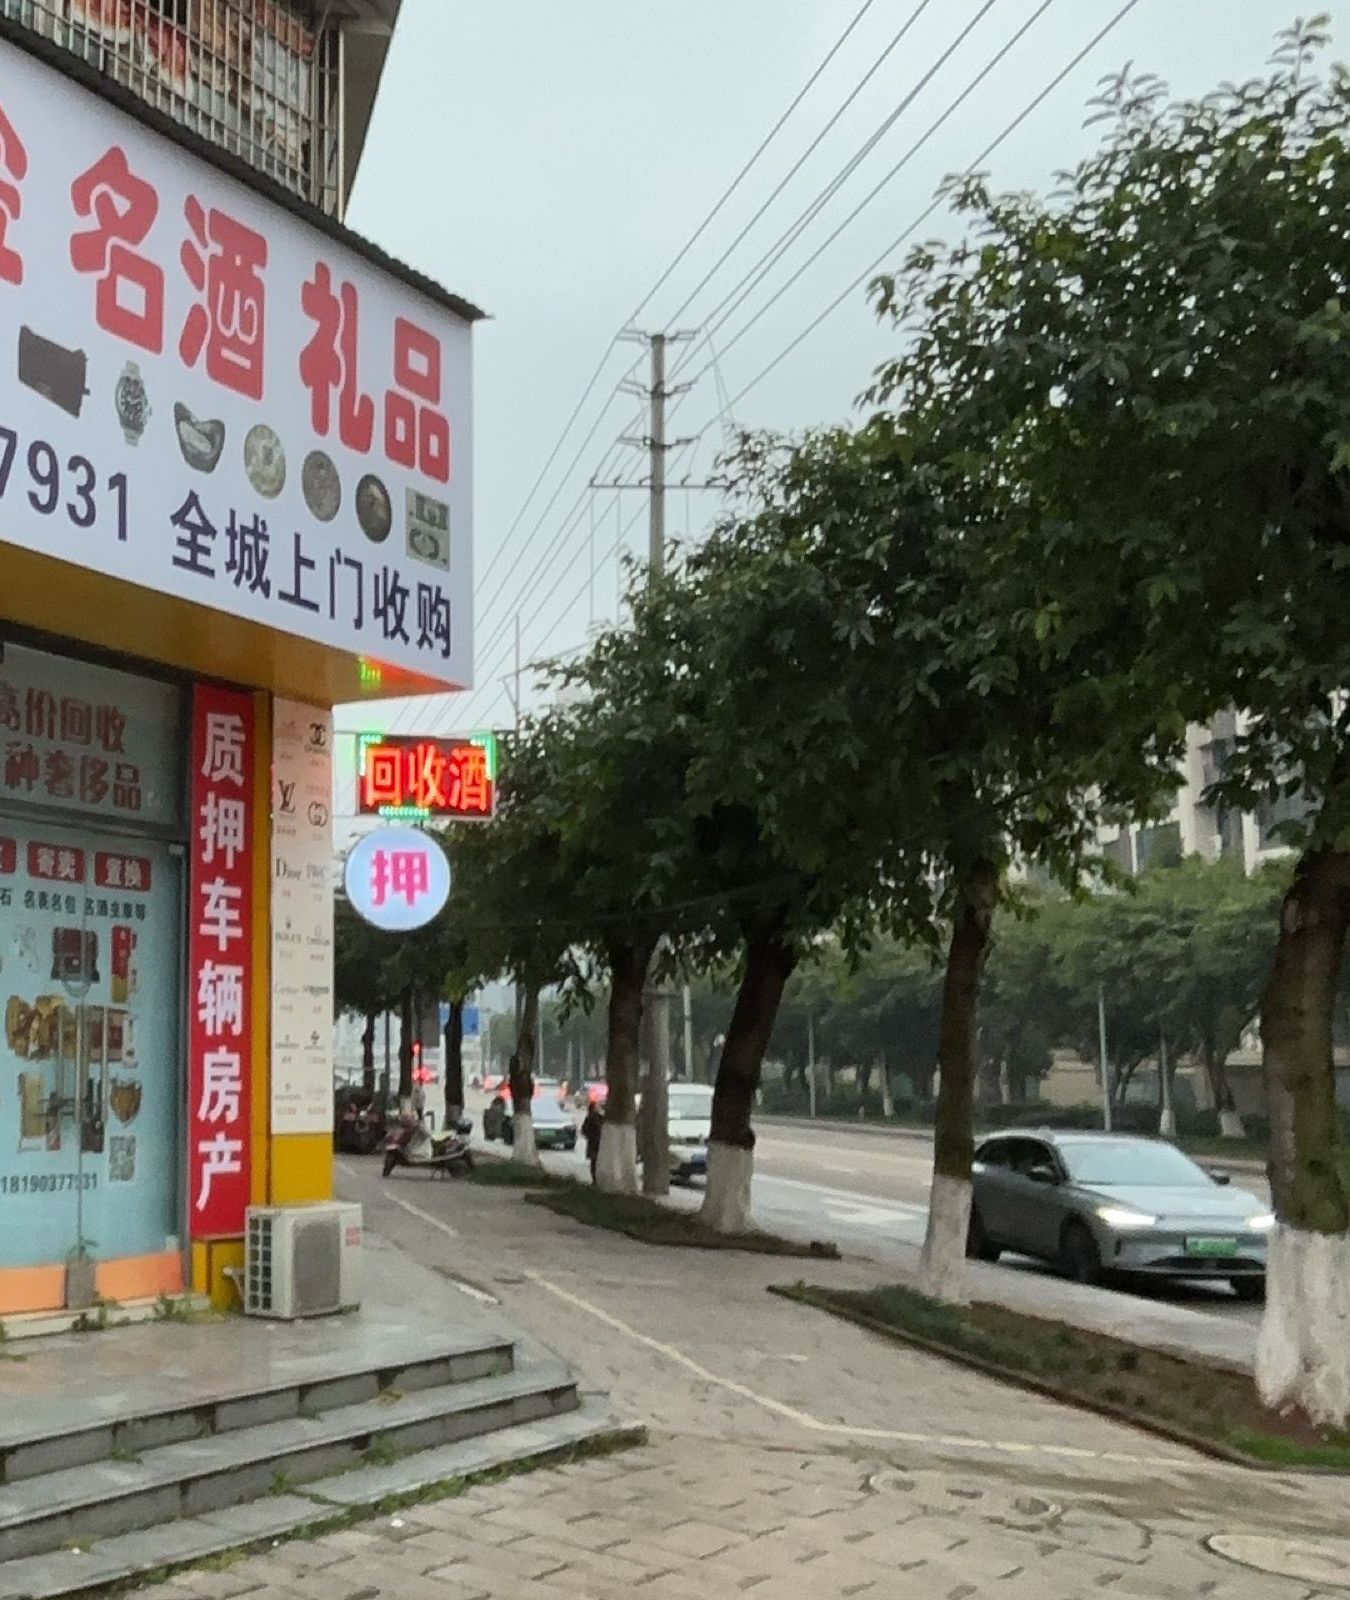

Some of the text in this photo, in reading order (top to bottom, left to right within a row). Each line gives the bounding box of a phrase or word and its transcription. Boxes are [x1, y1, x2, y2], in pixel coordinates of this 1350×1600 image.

[170, 491, 450, 658] 全城上门收购
[366, 743, 488, 812] 回收酒
[370, 849, 431, 907] 押
[196, 712, 248, 1211] 质押车辆房产
